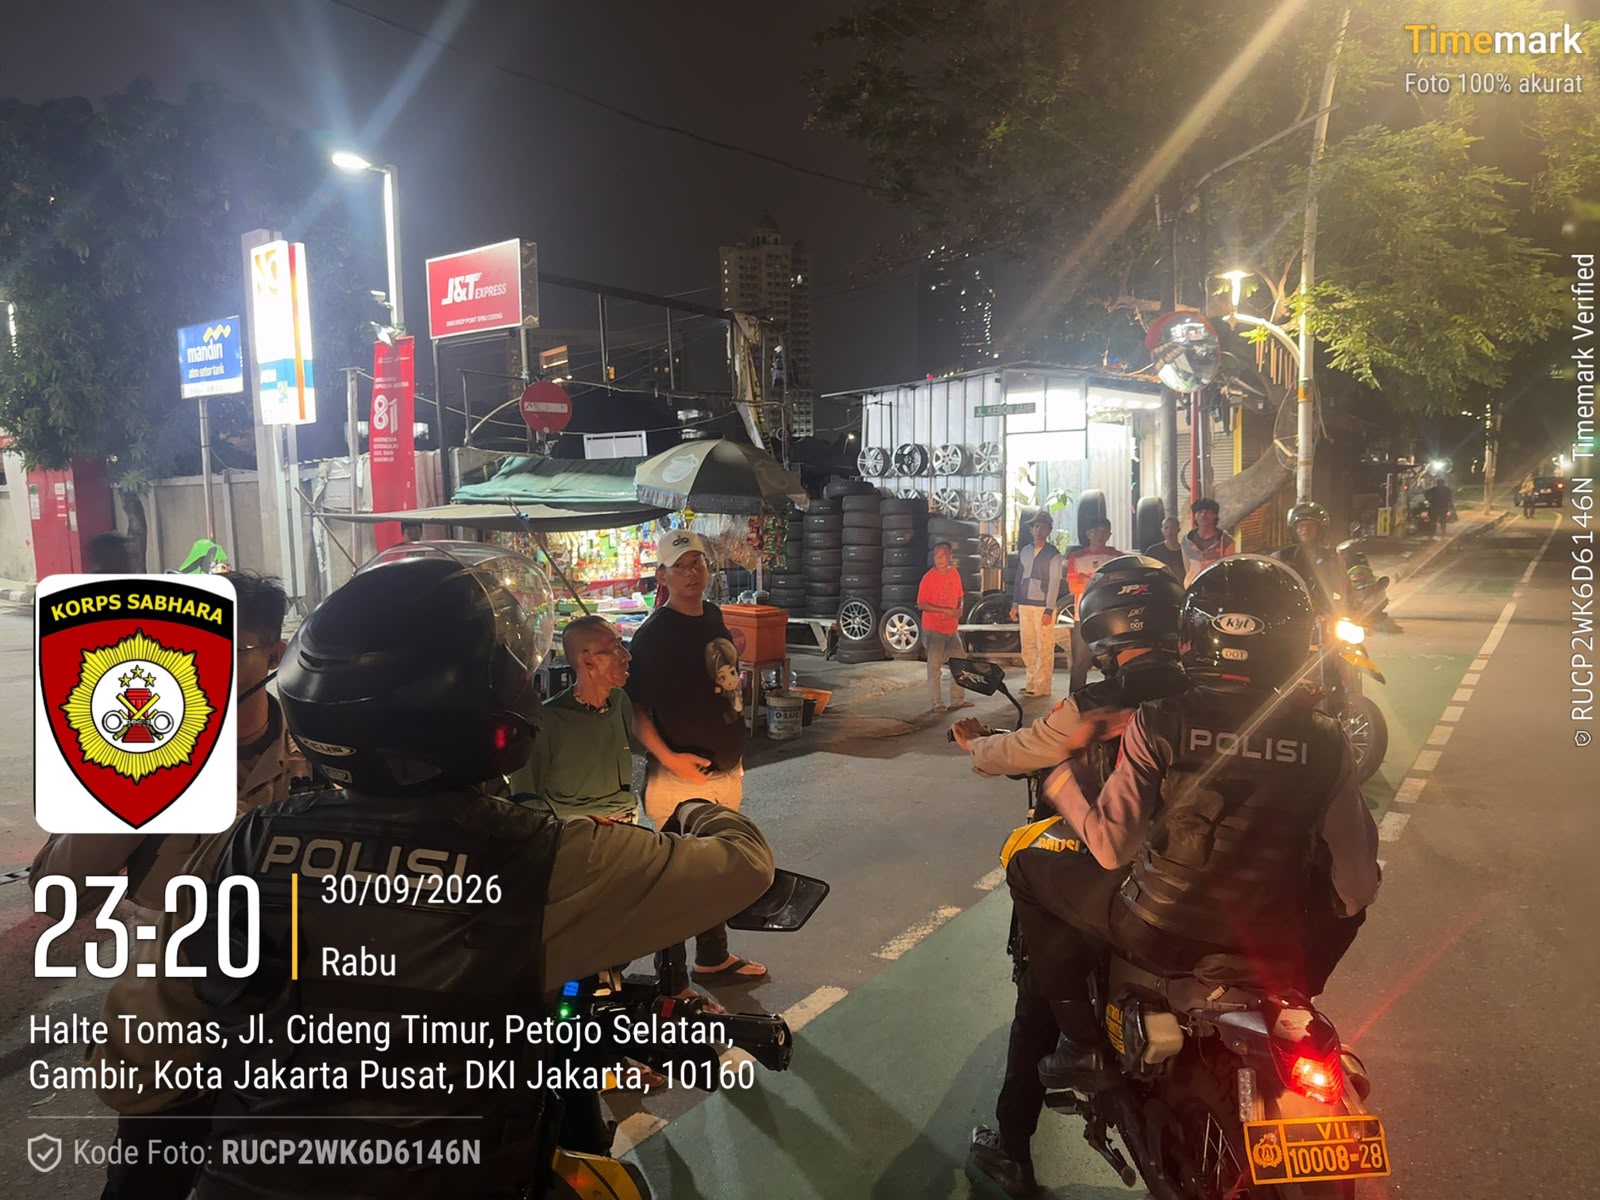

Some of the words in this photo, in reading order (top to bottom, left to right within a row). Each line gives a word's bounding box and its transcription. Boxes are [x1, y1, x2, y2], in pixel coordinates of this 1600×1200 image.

[441, 272, 482, 305] J&T
[475, 283, 507, 299] EXPRESS
[373, 394, 398, 434] 81
[1117, 584, 1150, 596] JPX
[1225, 650, 1245, 658] DOT
[1190, 728, 1307, 765] POLISI
[260, 836, 468, 893] POLISI
[1316, 1122, 1349, 1140] VII
[1289, 1142, 1383, 1175] 10008-28
